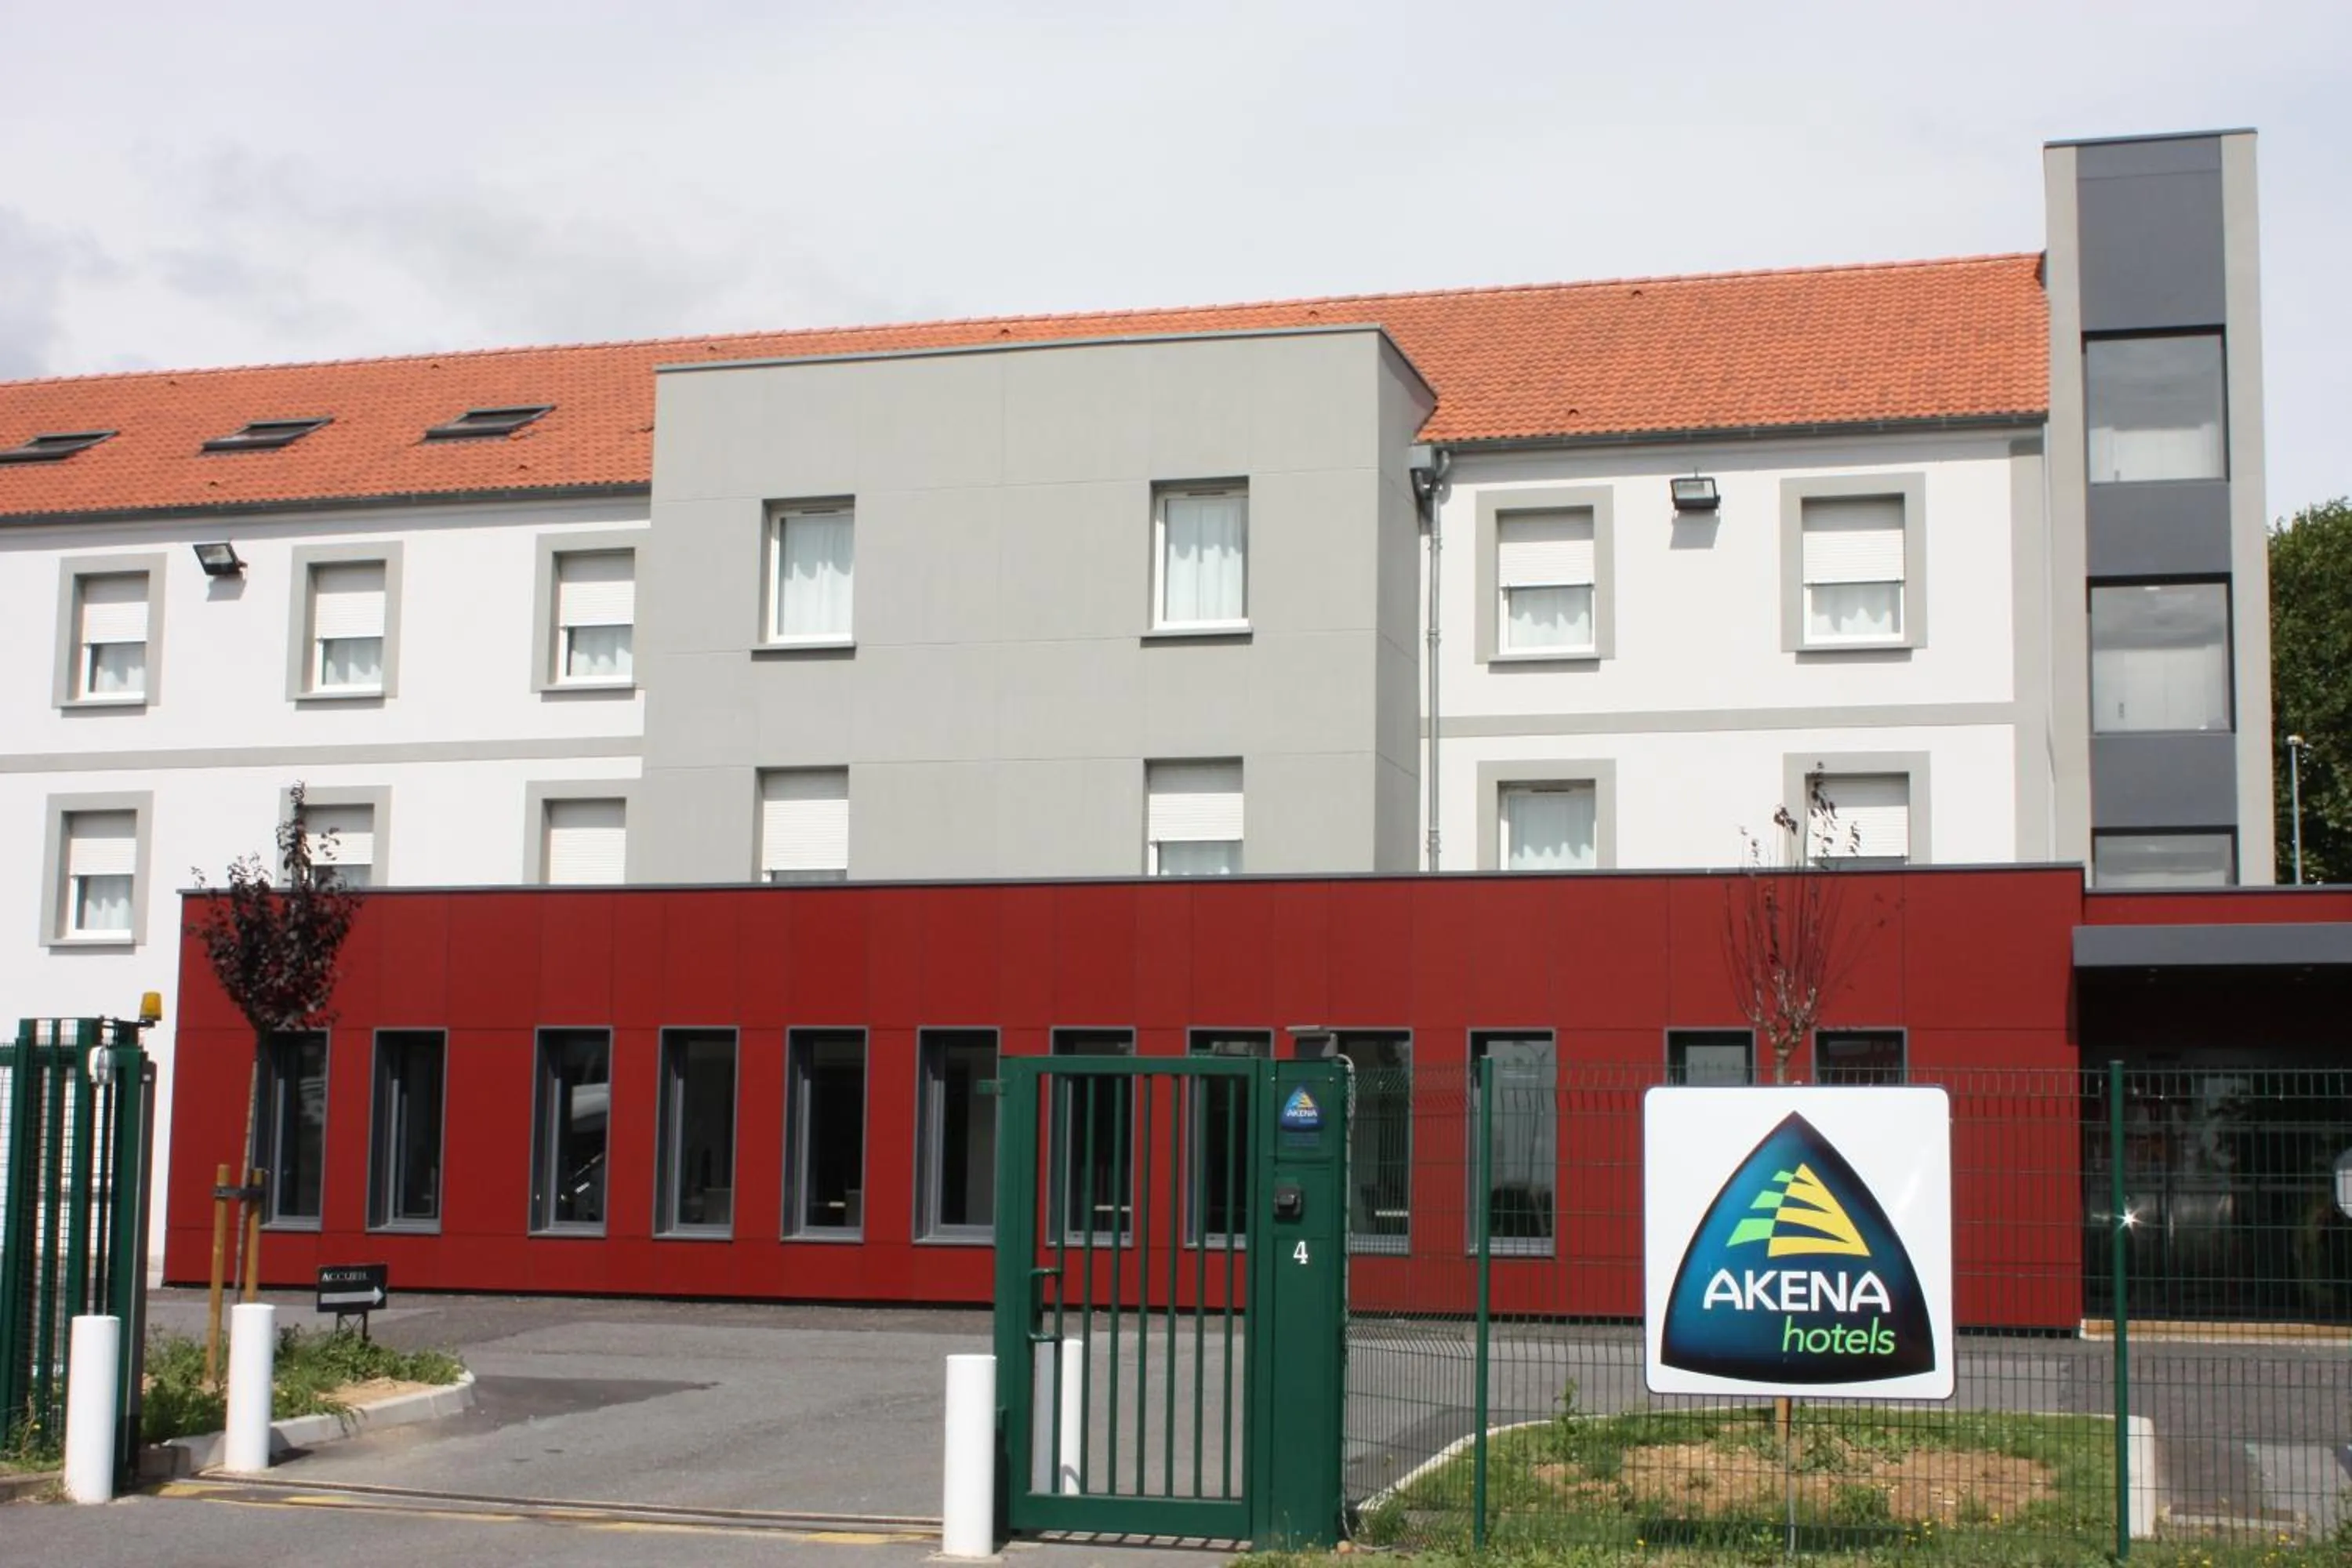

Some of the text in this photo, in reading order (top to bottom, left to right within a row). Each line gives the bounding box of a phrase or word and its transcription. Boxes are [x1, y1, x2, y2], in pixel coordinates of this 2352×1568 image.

[1294, 1241, 1308, 1265] 4
[1702, 1267, 1892, 1313] AKENA
[1782, 1315, 1895, 1355] hotels
